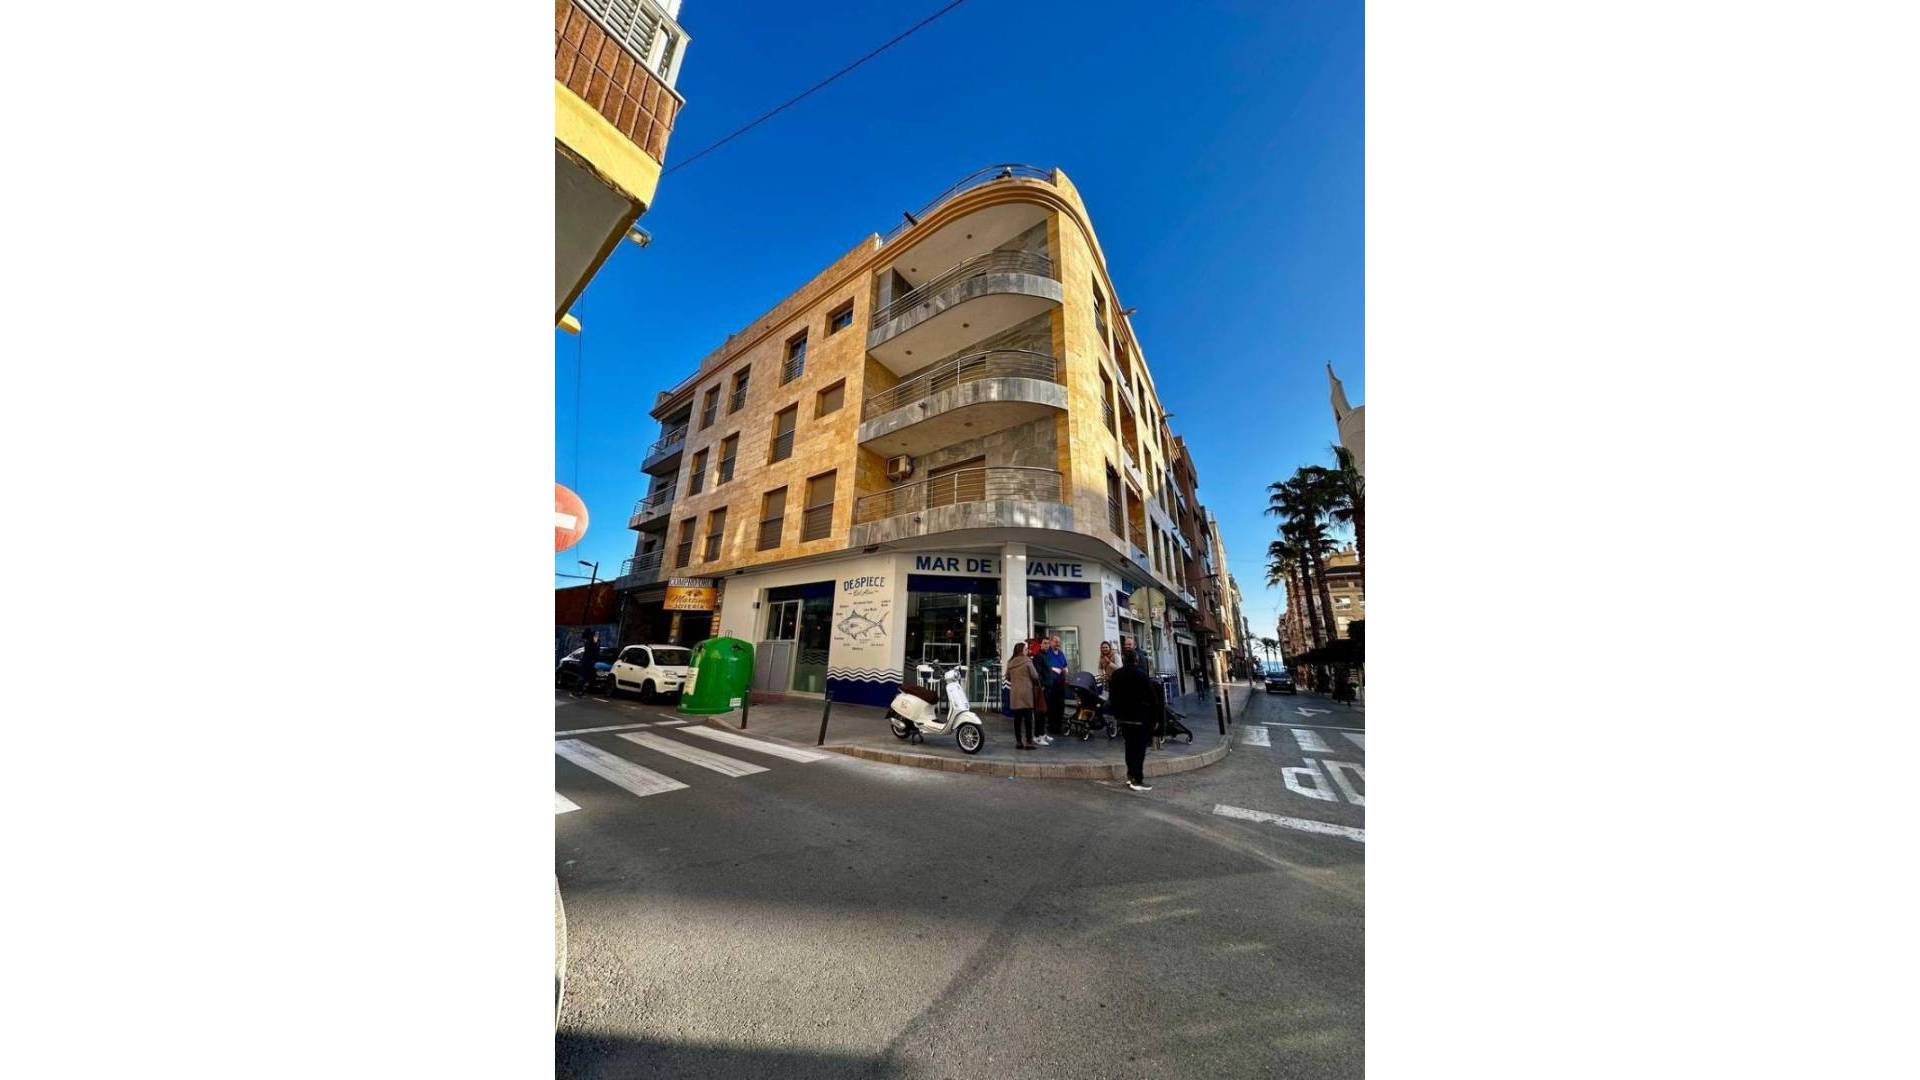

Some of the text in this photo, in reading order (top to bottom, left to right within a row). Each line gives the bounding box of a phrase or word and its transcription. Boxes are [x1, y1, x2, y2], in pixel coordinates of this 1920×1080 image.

[916, 555, 960, 572] MAR
[966, 558, 992, 573] DE
[843, 576, 886, 591] DESPIECE
